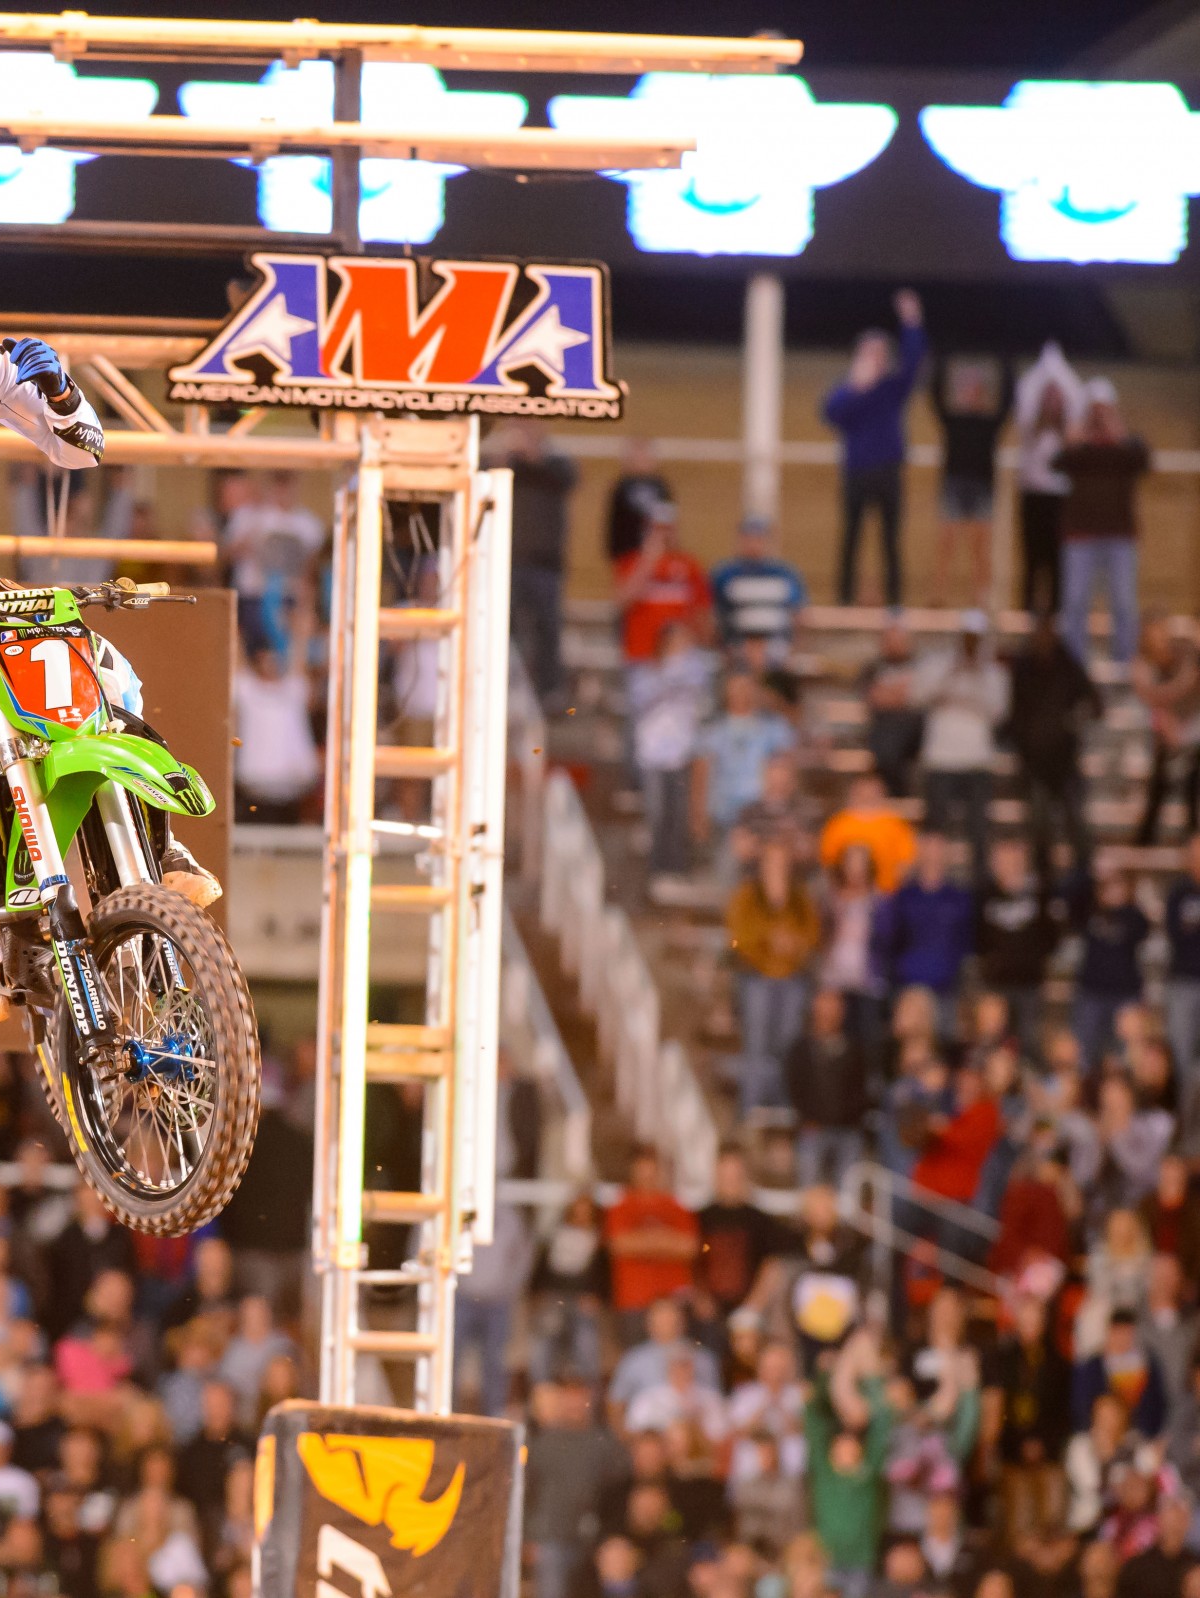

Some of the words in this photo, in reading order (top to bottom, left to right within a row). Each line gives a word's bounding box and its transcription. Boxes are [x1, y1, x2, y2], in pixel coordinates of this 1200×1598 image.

[168, 252, 620, 400] AMA
[169, 383, 289, 404] AMERICAN
[291, 387, 469, 412] MOTORCYCLIST
[467, 394, 619, 419] ASSOCIATION
[30, 639, 73, 710] 1
[10, 786, 42, 862] SHOWA
[55, 940, 90, 1036] DUNLOP
[83, 969, 107, 1031] CARRILLO
